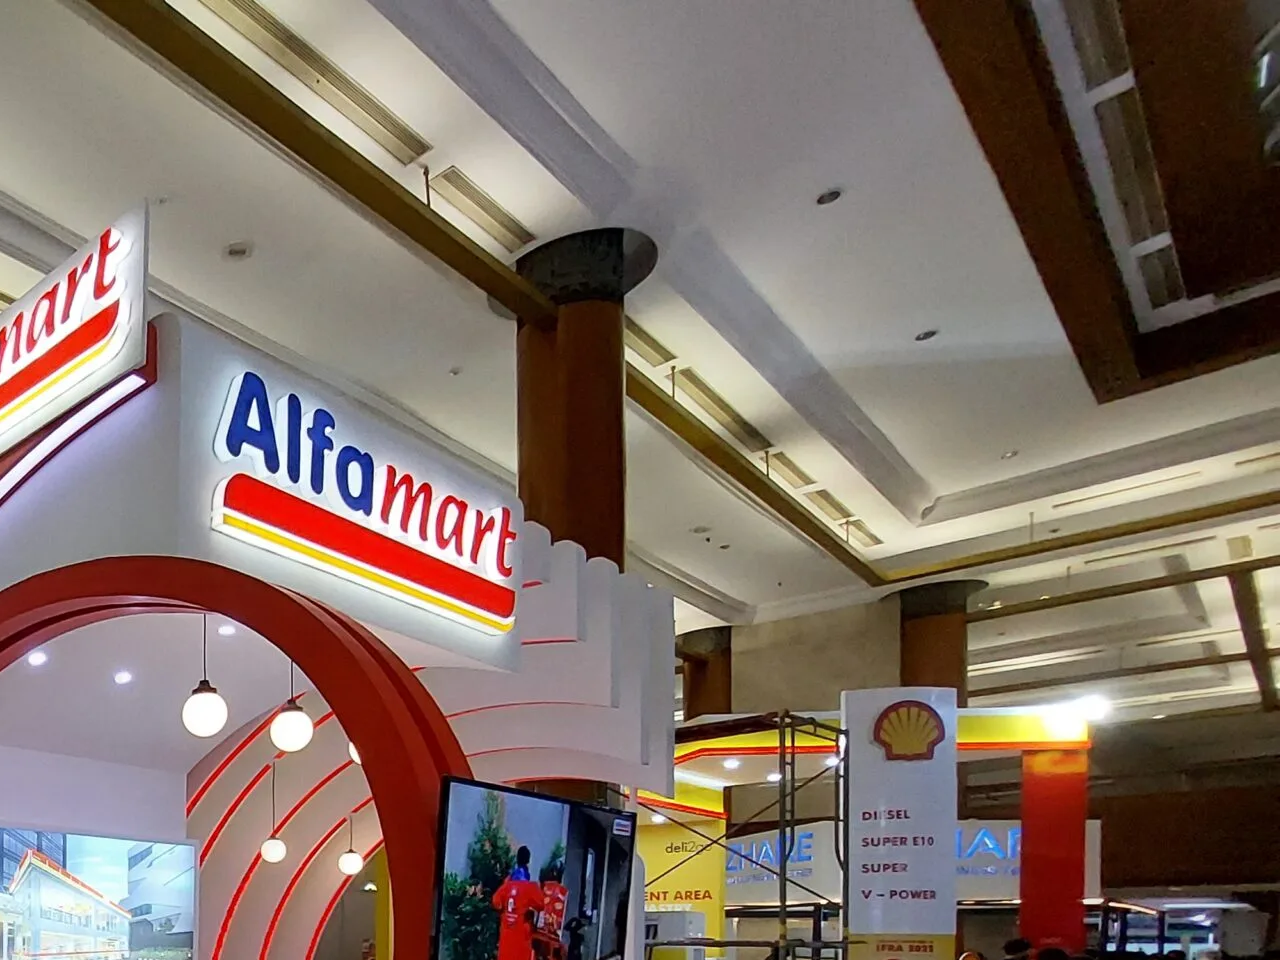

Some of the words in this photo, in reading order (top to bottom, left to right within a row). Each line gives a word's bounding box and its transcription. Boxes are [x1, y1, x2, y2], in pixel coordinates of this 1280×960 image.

[225, 371, 516, 578] Alfamart
[862, 837, 908, 847] SUPER
[913, 836, 934, 846] E10
[861, 863, 908, 873] SUPER
[673, 890, 713, 900] AREA
[861, 890, 872, 899] V
[889, 890, 936, 900] POWER
